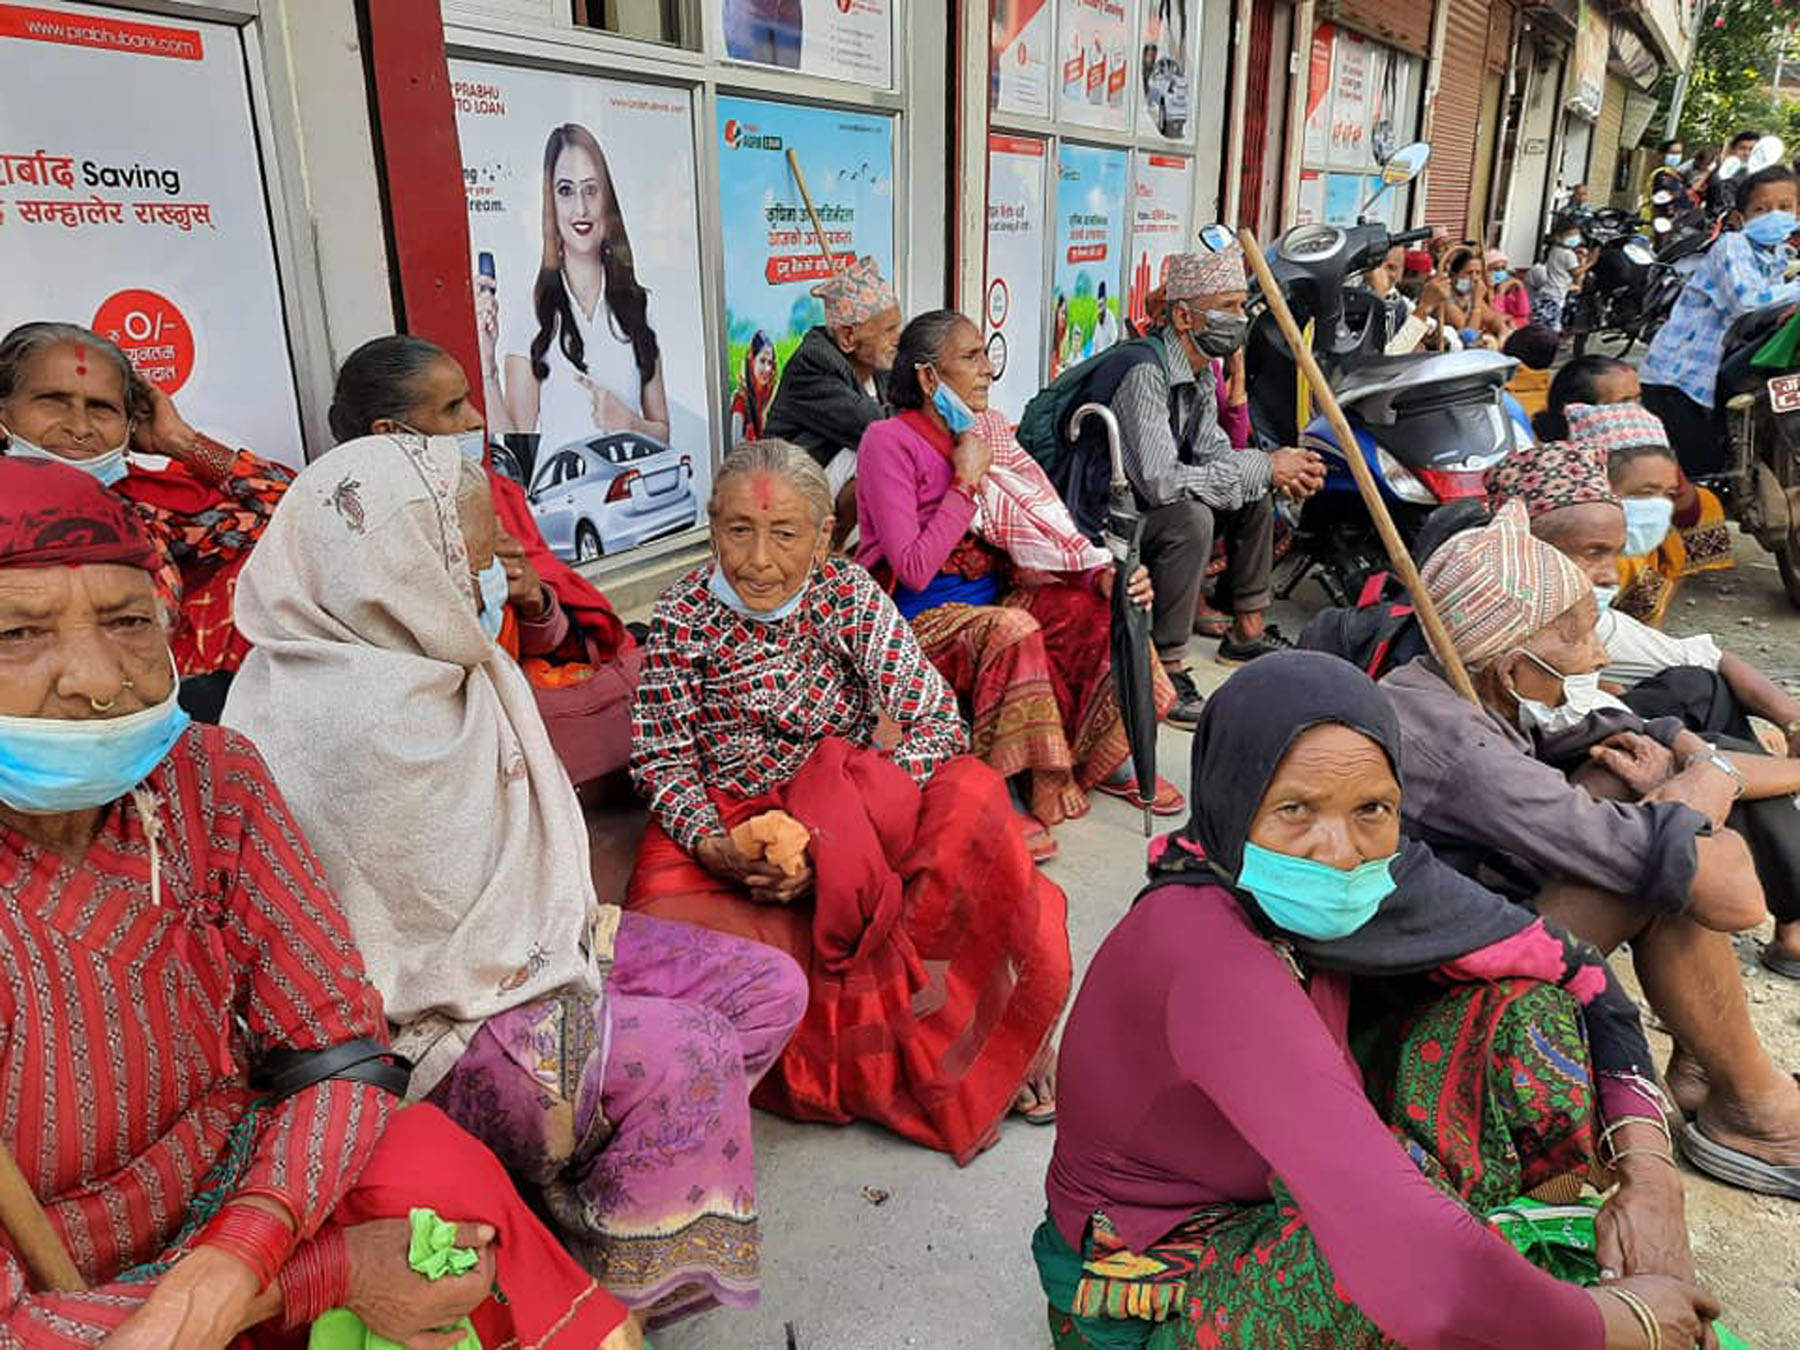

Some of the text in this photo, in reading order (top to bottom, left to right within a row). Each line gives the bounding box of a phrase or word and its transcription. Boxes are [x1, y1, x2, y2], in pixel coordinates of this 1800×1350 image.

[455, 82, 500, 100] PRABHU
[475, 100, 505, 115] LOAN
[82, 161, 180, 195] Saving
[15, 195, 124, 228] सम्हालेर
